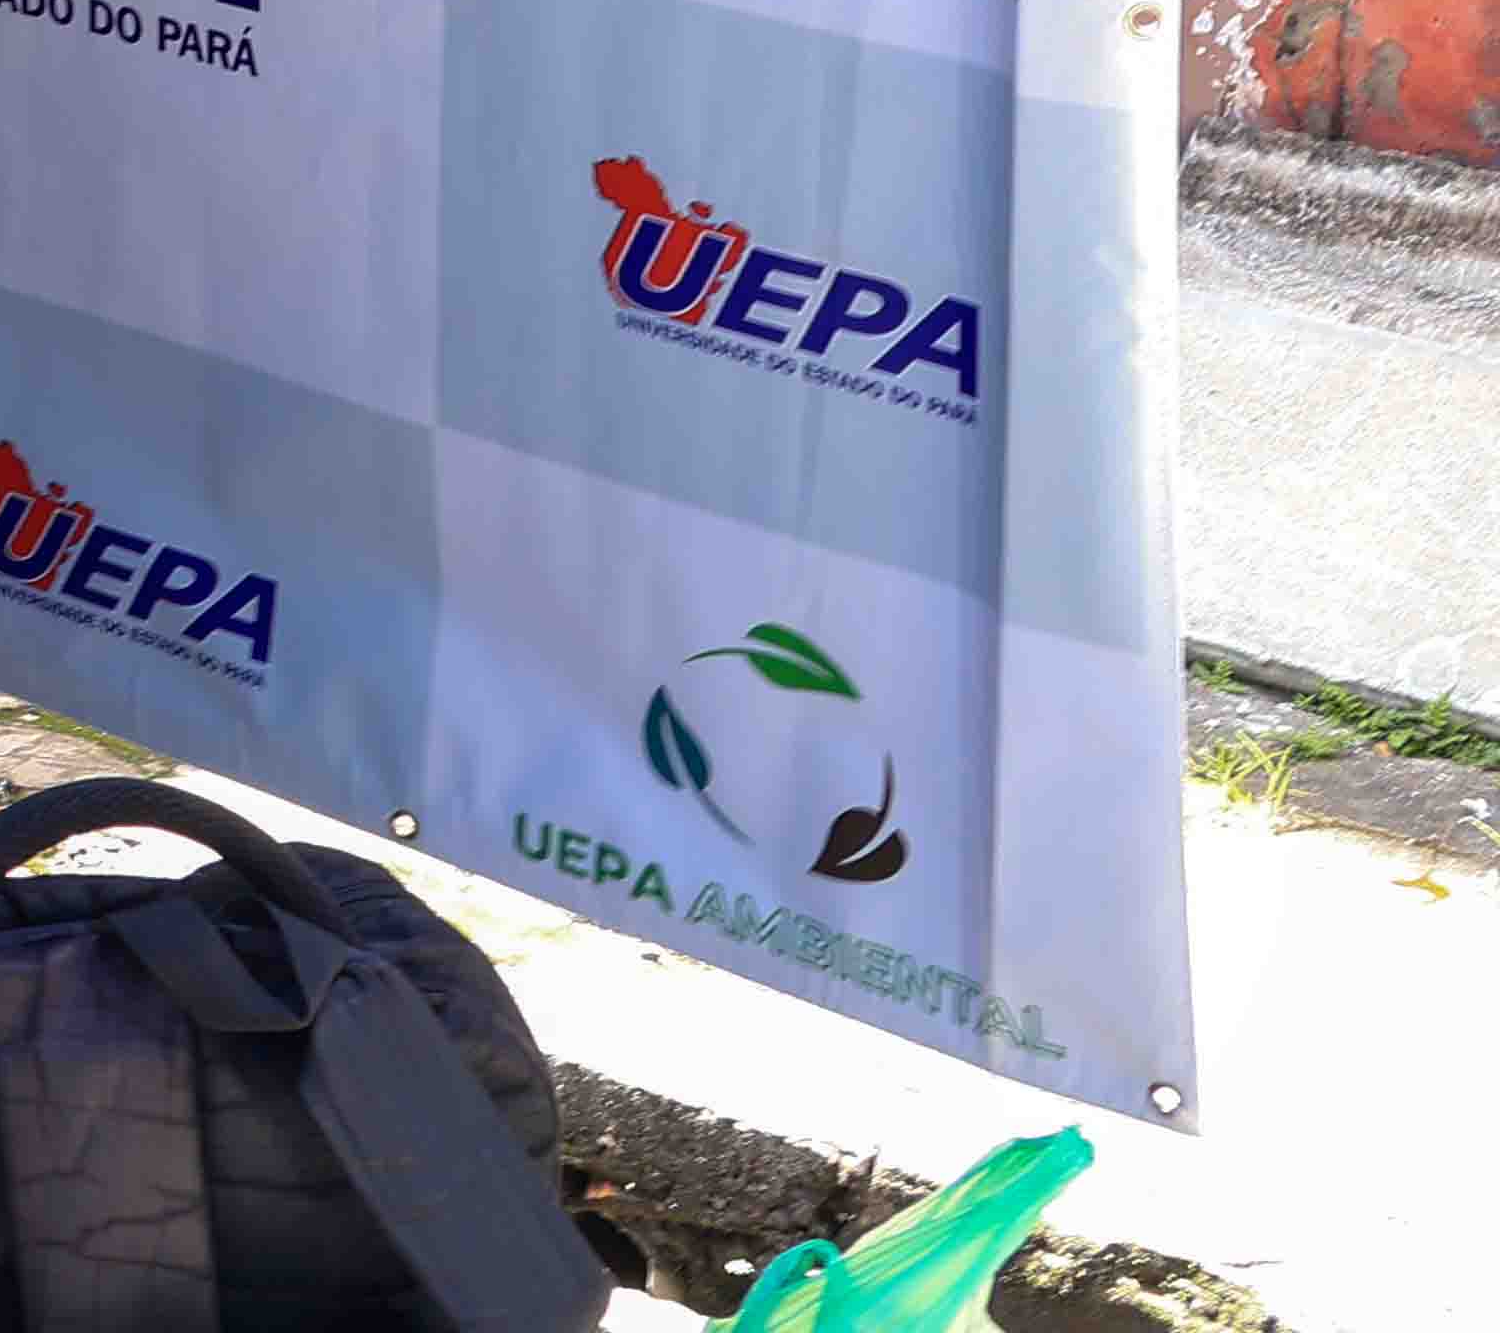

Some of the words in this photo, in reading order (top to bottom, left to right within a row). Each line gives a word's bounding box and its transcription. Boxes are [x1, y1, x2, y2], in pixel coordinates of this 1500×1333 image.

[157, 15, 261, 78] PARÁ
[614, 215, 980, 399] UEPA
[514, 812, 675, 914] UEPA
[685, 881, 1068, 1060] AMBIENTAL
